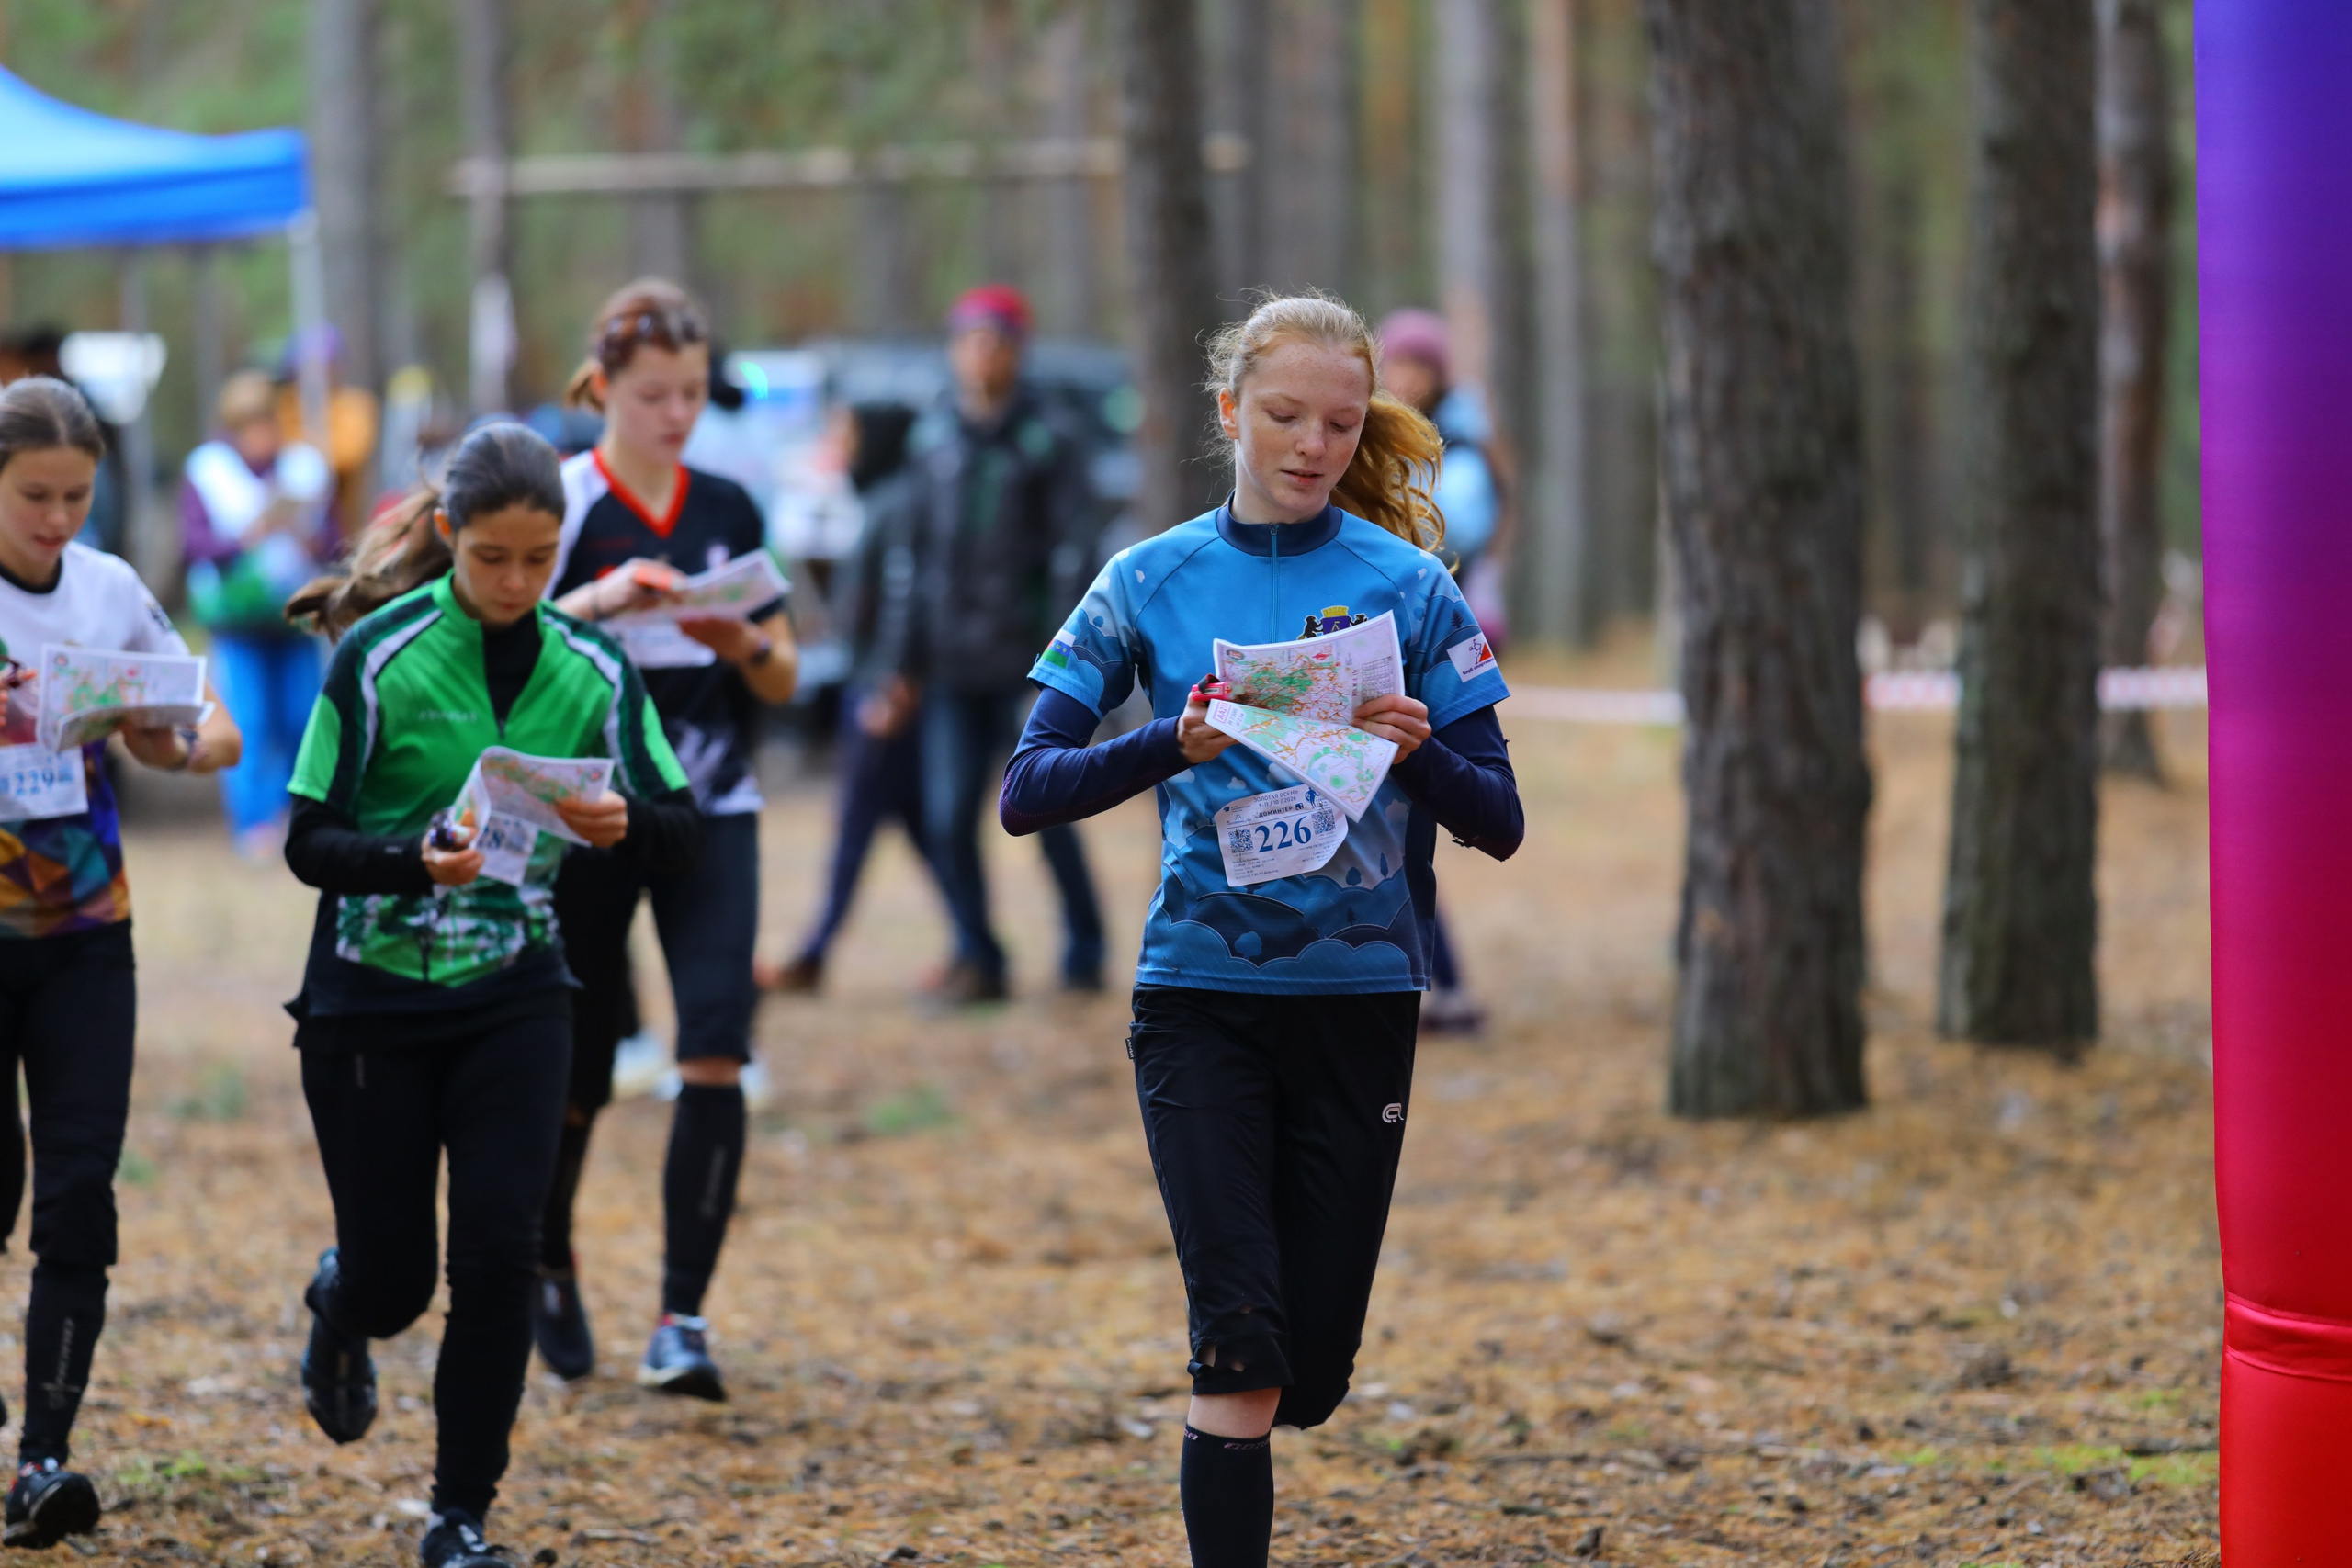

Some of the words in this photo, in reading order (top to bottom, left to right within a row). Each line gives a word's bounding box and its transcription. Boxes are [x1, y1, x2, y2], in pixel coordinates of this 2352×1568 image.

[1463, 667, 1473, 675] Клуб
[15, 768, 55, 796] 229
[1252, 794, 1279, 804] ЗОЛОТАЯ
[1279, 789, 1299, 798] ОСЕНЬ
[1258, 806, 1294, 818] ДОМИНТЕР
[1254, 815, 1312, 853] 226
